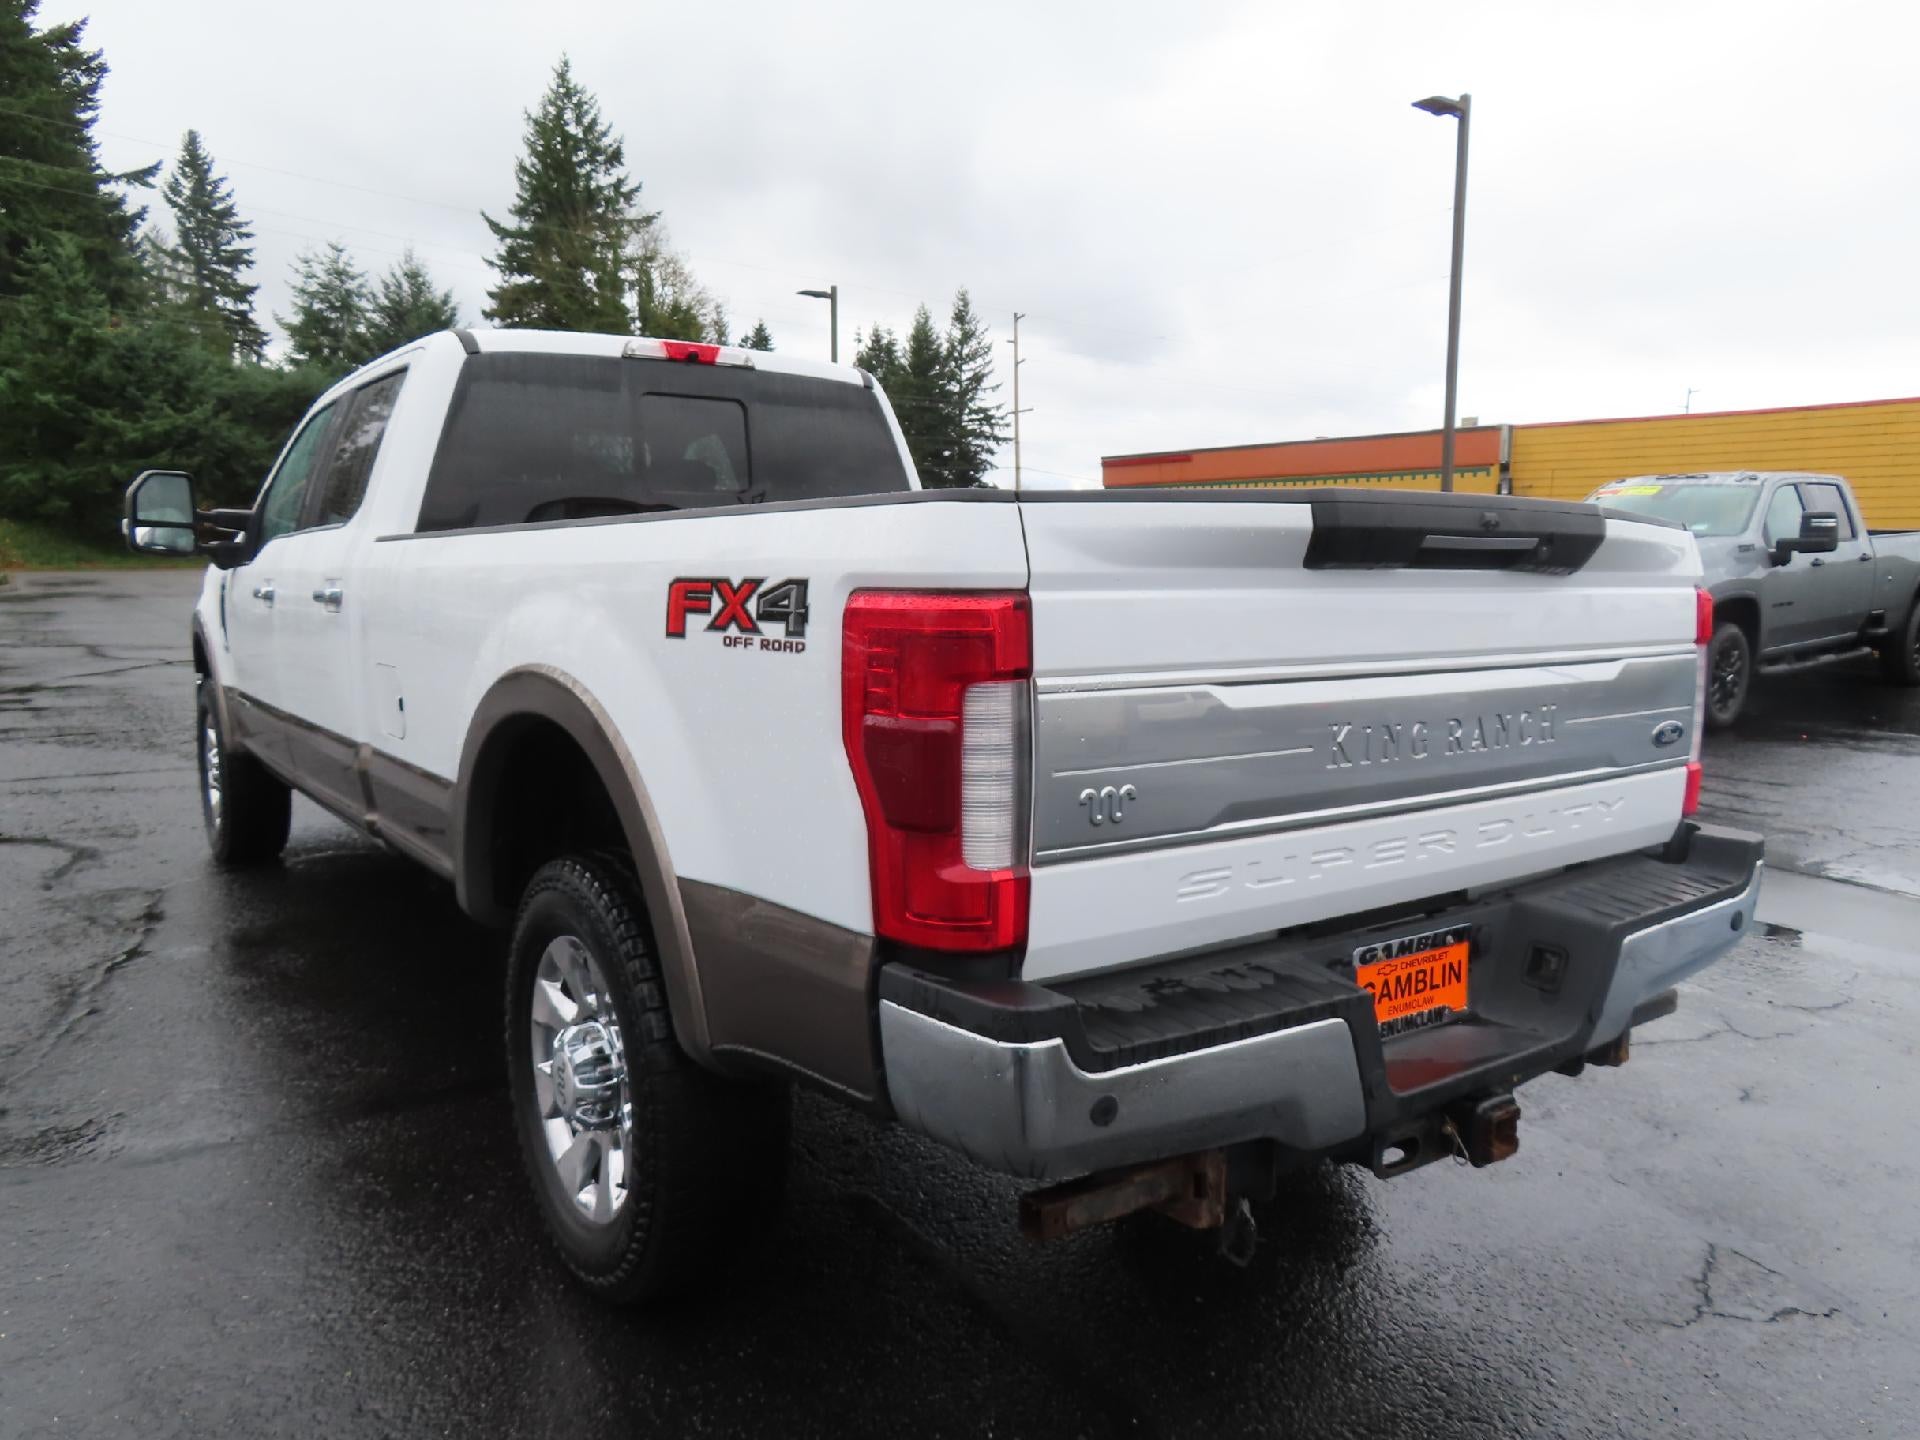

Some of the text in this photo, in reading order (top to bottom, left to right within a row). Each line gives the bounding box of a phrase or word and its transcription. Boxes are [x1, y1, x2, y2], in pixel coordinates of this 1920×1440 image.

[666, 577, 809, 639] FX4
[722, 635, 806, 654] OFF ROAD
[1325, 703, 1558, 769] KING RANCH
[1176, 796, 1625, 903] SUPER DUTY
[1400, 951, 1450, 970] CHEVROLET
[1387, 995, 1434, 1016] ENUMCLAW
